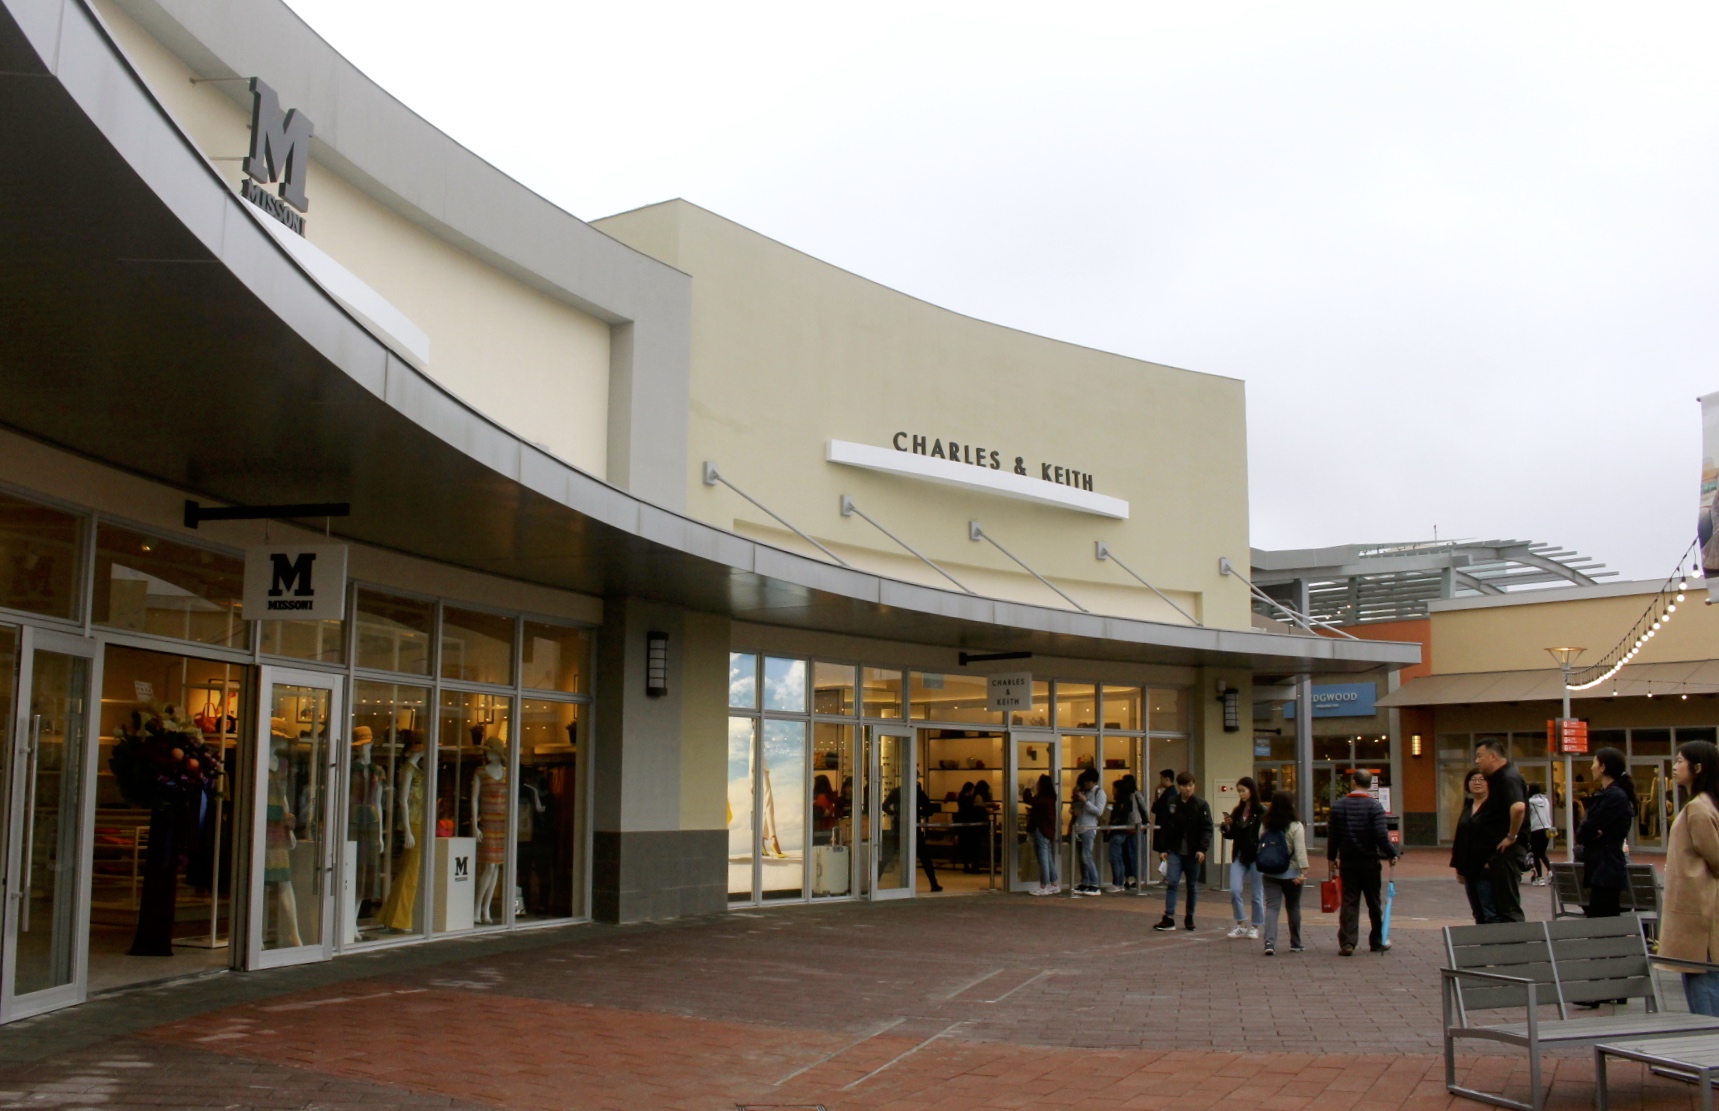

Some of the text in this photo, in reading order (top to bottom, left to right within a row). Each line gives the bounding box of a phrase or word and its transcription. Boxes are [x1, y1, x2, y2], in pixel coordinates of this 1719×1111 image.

[242, 76, 314, 213] M
[240, 177, 306, 238] MISSONI
[893, 431, 1093, 492] CHARLES & KEITH
[268, 553, 316, 596] M
[267, 600, 313, 610] MISSONI
[992, 678, 1025, 687] CHARLES
[996, 698, 1020, 706] KEITH
[1311, 692, 1358, 702] DGWOOD
[454, 856, 468, 876] M
